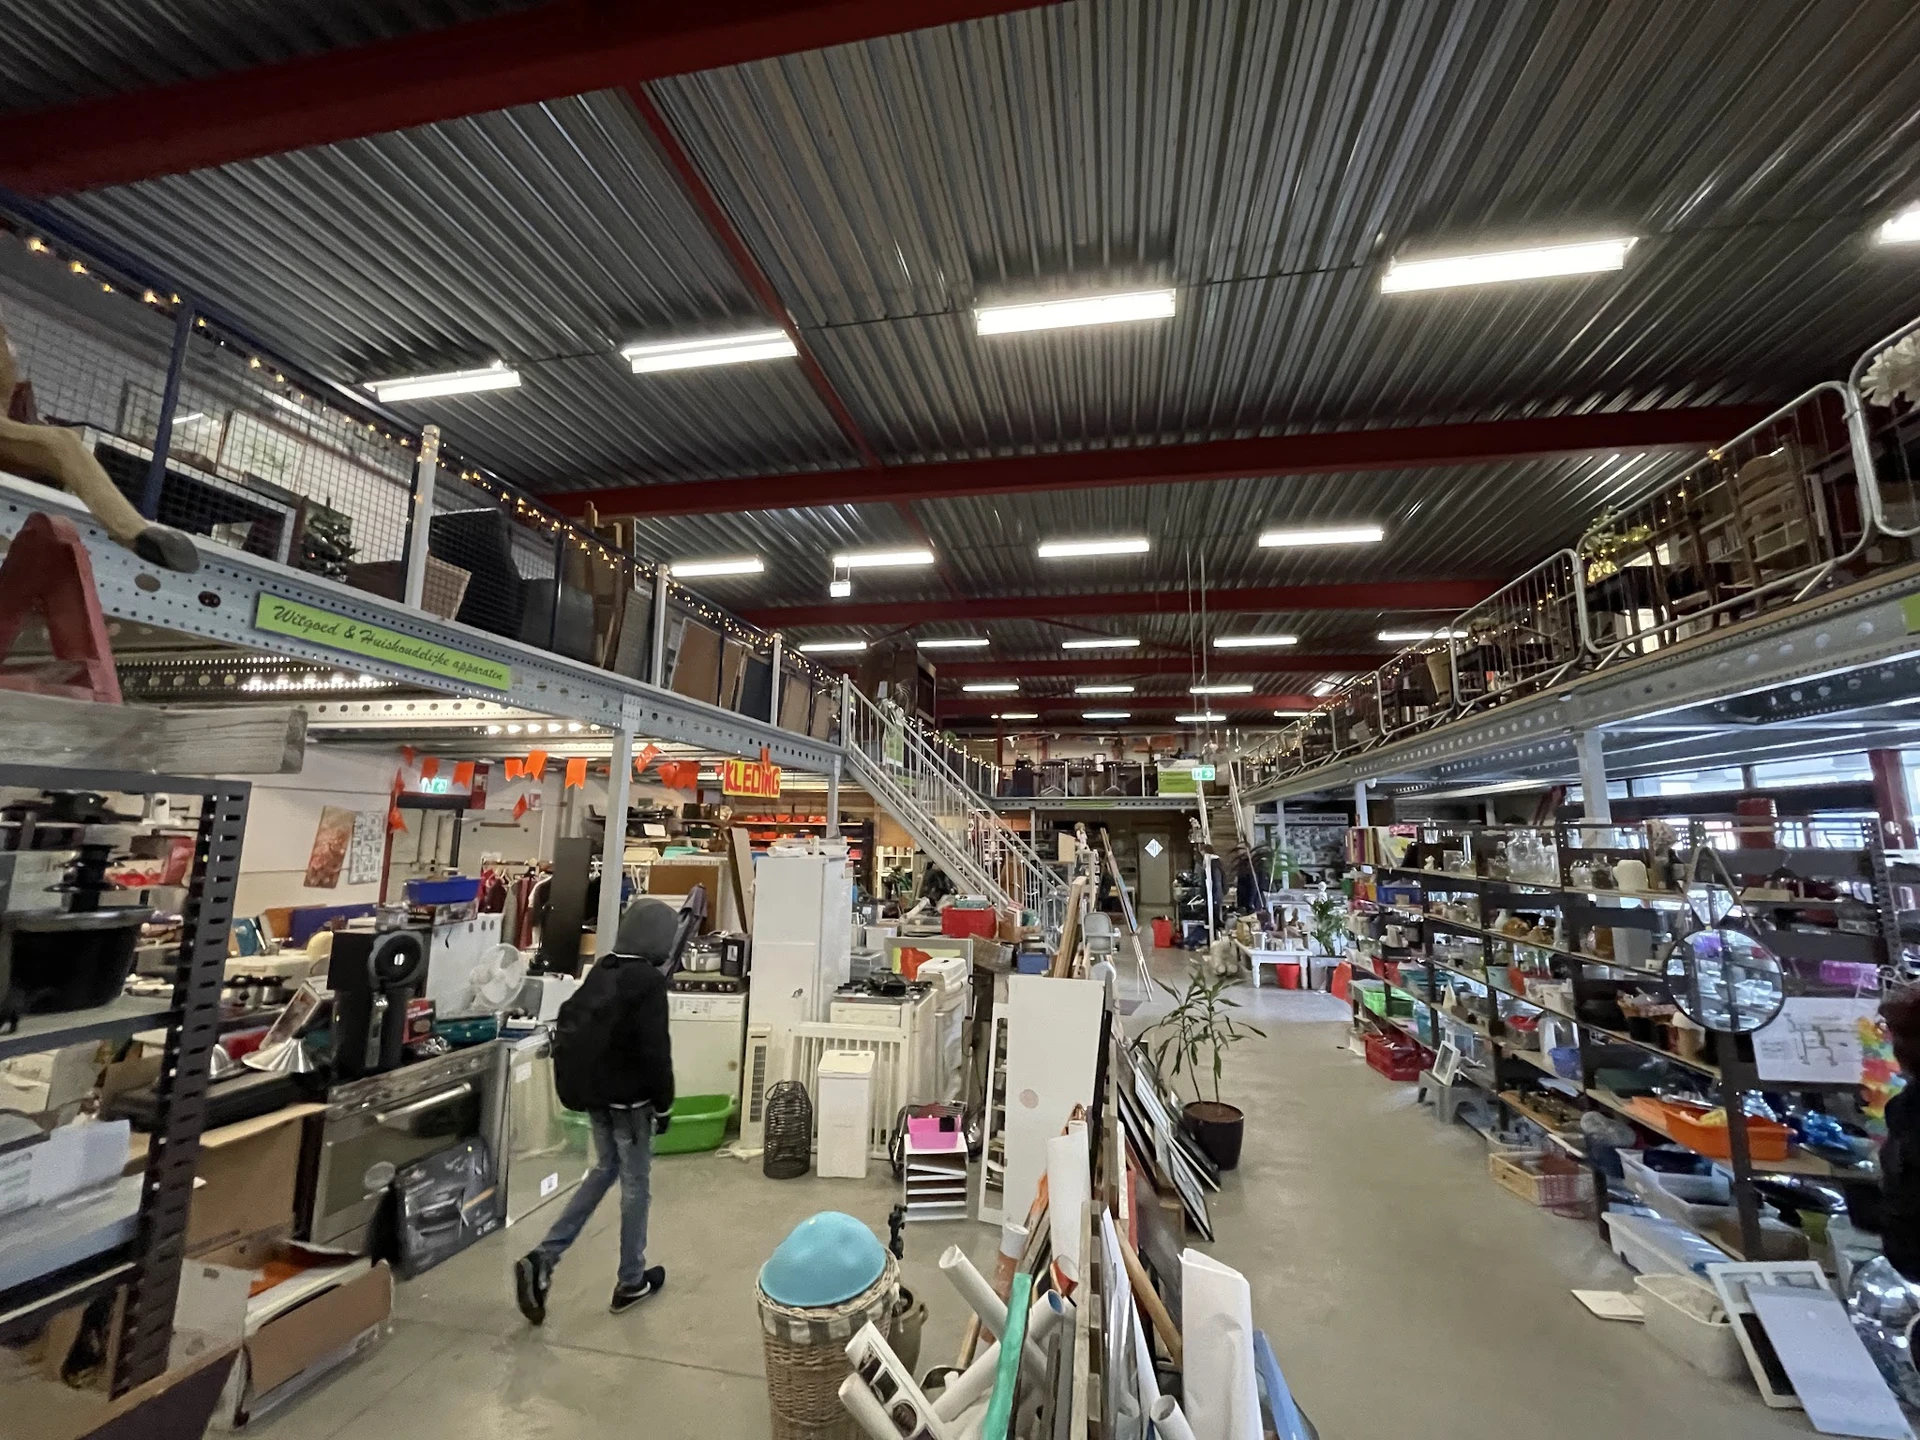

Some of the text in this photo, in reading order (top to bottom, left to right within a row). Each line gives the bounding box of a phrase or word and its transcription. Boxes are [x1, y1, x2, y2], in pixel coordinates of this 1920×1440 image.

[273, 605, 503, 681] Witgoed & Huishoudelijke apparaten
[725, 760, 780, 797] KLEDING
